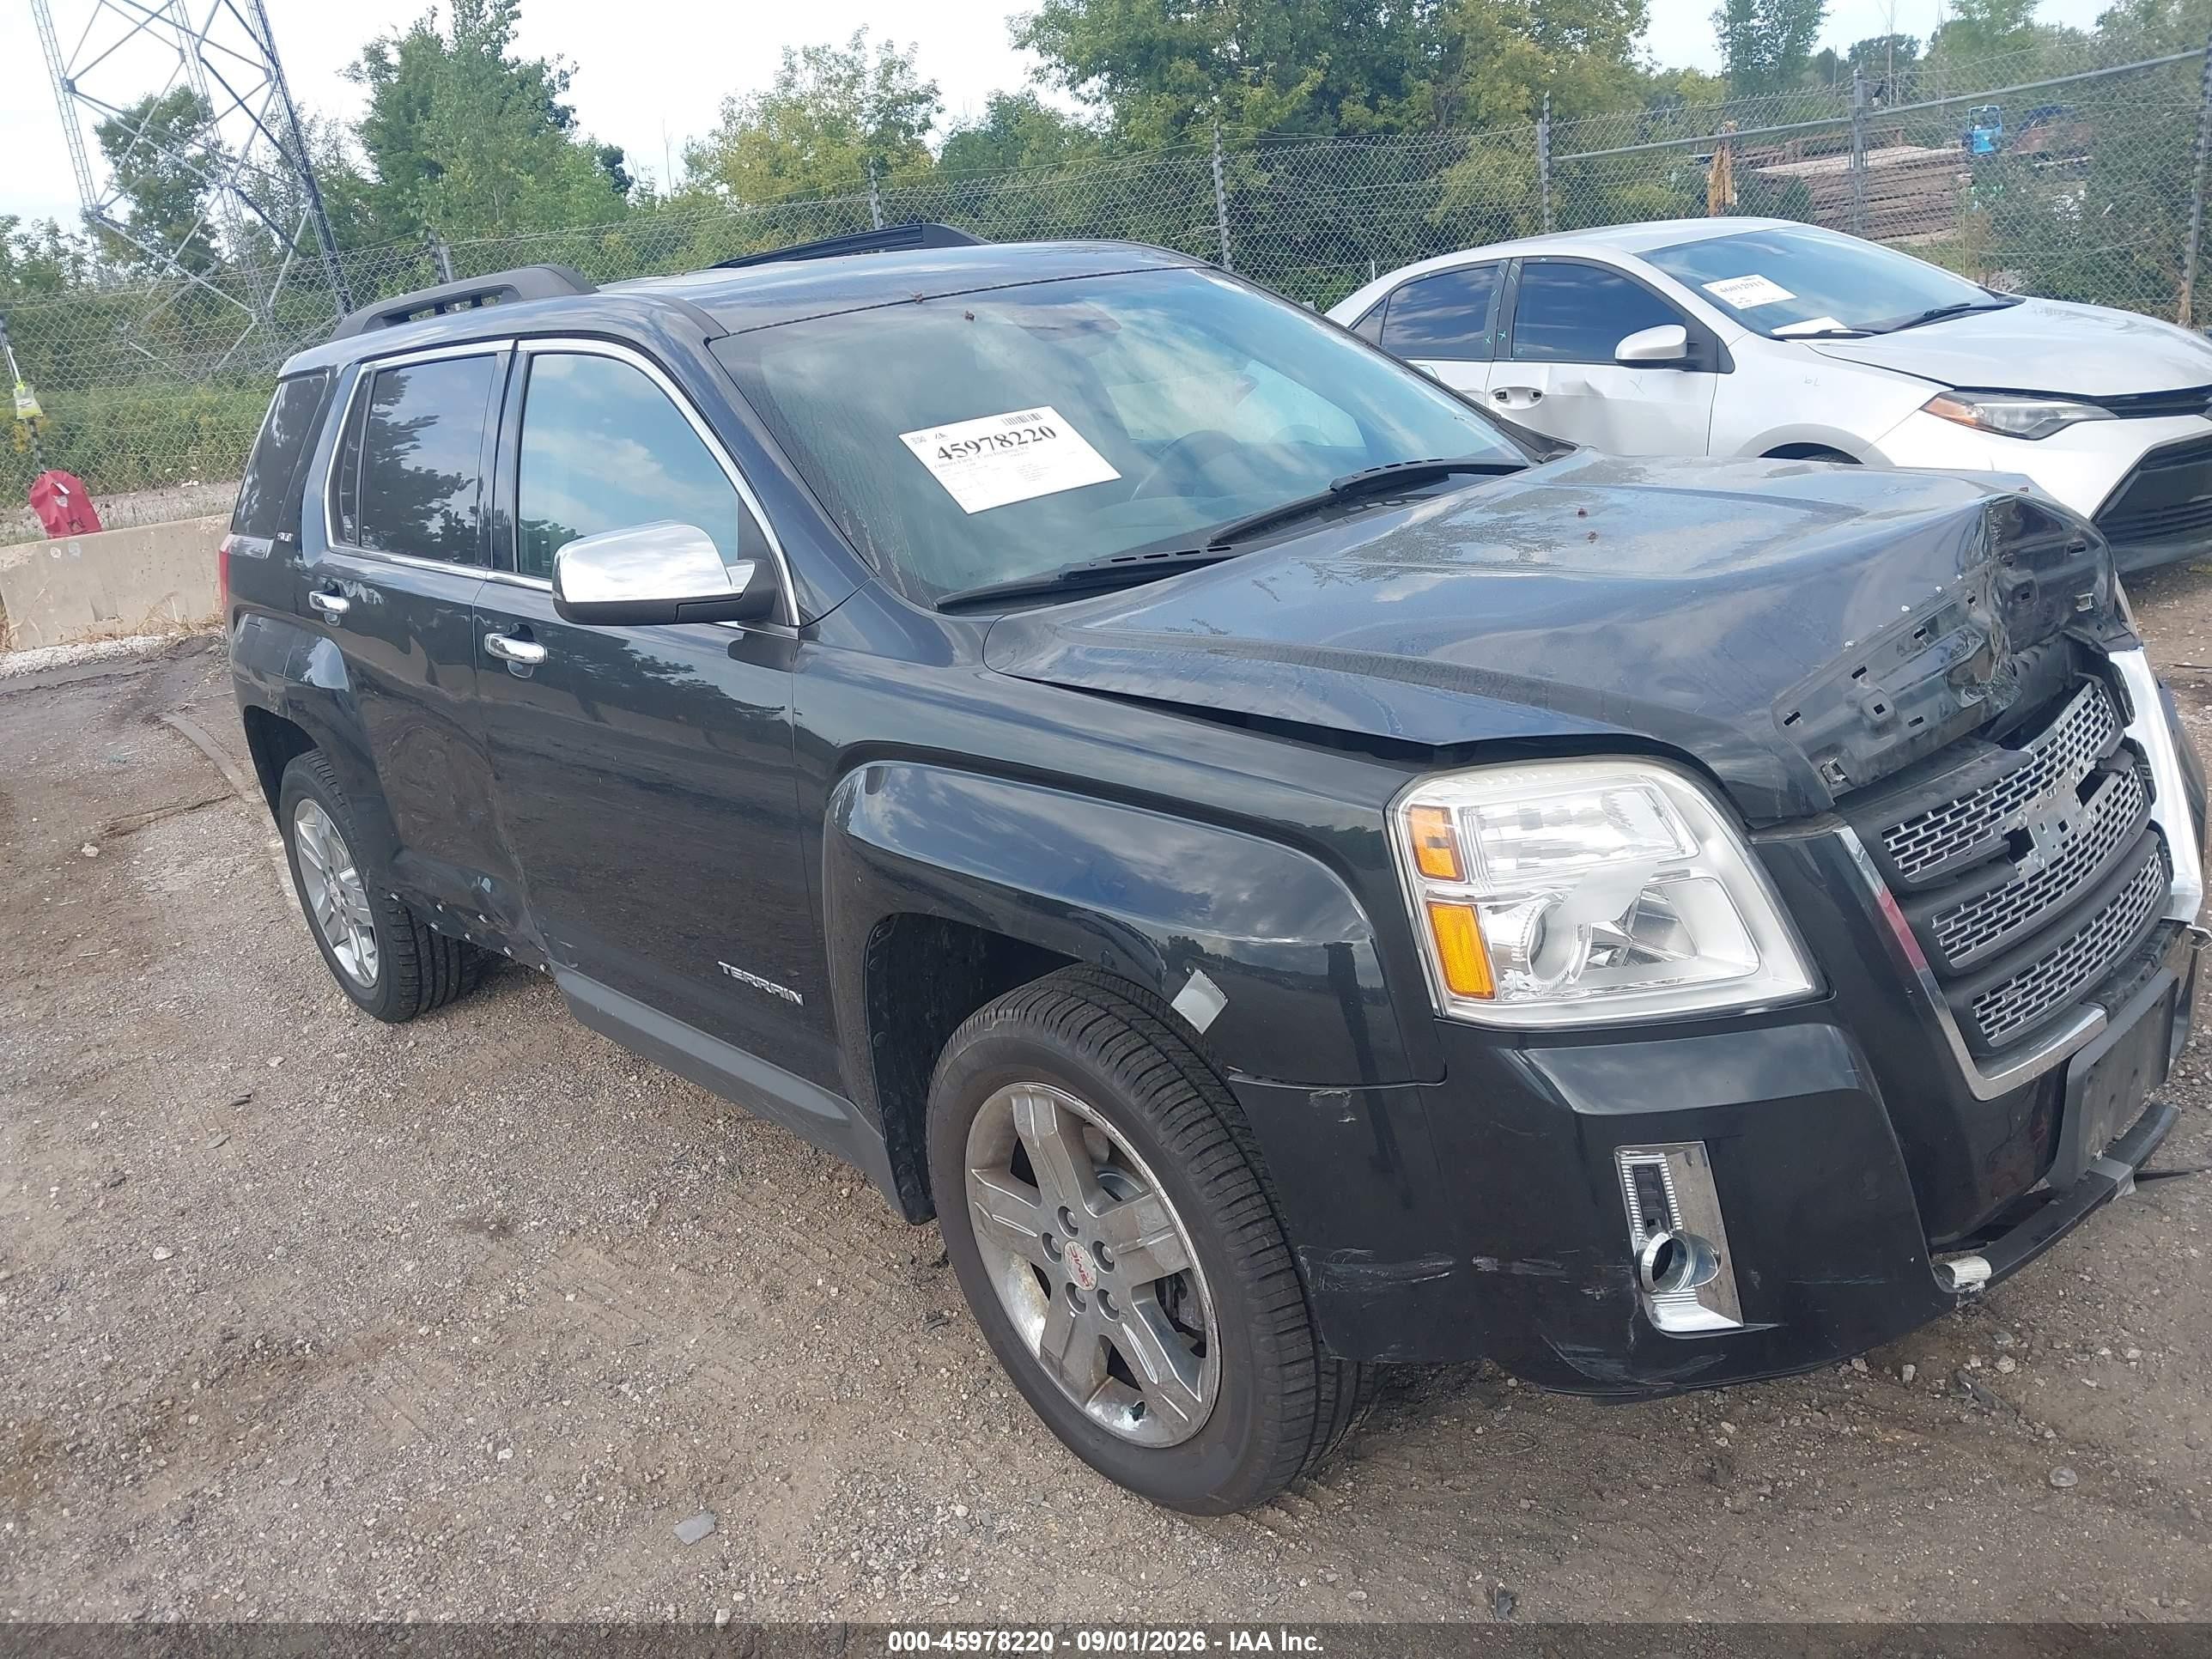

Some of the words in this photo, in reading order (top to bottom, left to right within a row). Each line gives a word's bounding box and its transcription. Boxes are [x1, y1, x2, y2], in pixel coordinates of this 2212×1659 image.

[937, 426, 1057, 460] 45978220
[718, 961, 804, 1006] TERRAIN
[1068, 1245, 1091, 1287] GMC
